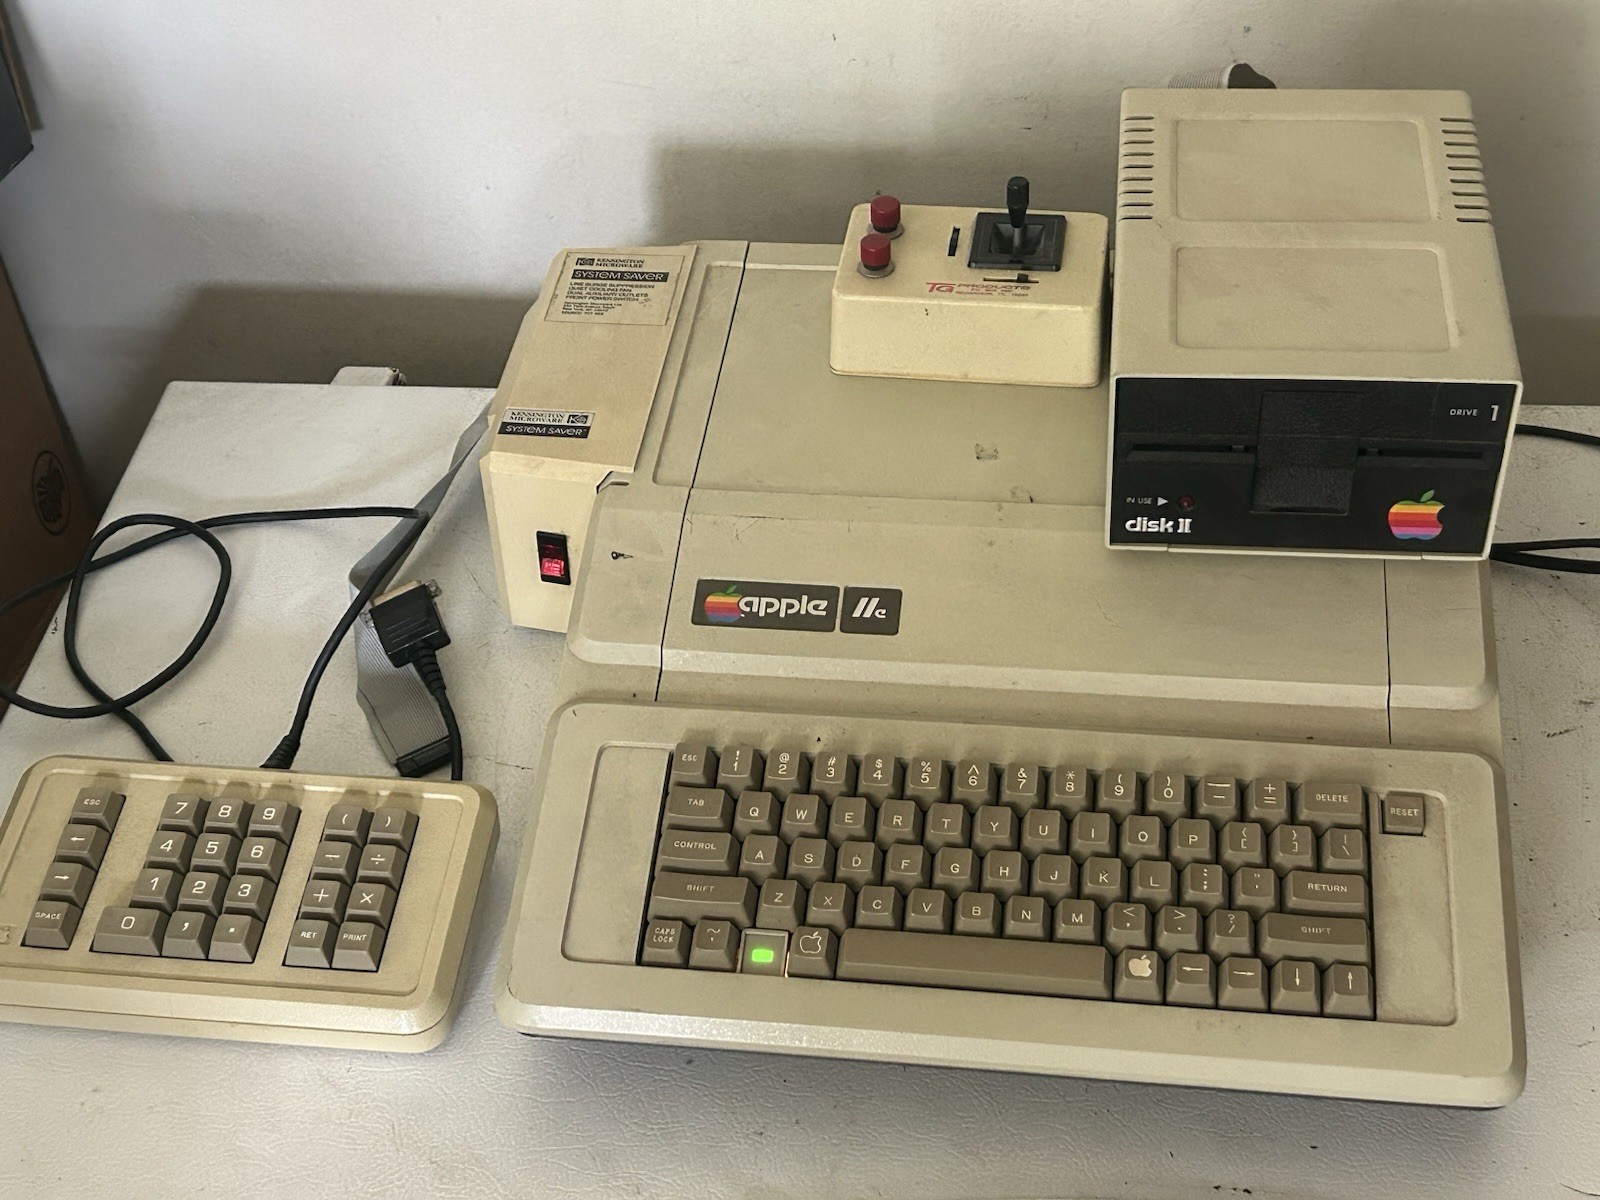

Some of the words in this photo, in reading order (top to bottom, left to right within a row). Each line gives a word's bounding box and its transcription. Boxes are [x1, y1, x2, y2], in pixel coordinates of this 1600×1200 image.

[926, 282, 956, 293] TG
[511, 411, 565, 419] KENSINGTON
[1449, 408, 1478, 417] DRIVE
[1490, 404, 1499, 422] 1
[1137, 497, 1153, 505] USE
[1124, 516, 1175, 533] disk
[738, 594, 829, 618] apple
[681, 754, 698, 762] ESC
[736, 750, 741, 760] !
[779, 752, 790, 764] @
[733, 762, 739, 772] 1
[827, 756, 837, 767] #
[875, 758, 883, 769] $
[920, 761, 932, 773] %
[778, 763, 787, 775] 2
[826, 767, 835, 778] 3
[1017, 767, 1028, 779] &
[872, 769, 883, 781] 4
[920, 772, 930, 784] 5
[968, 775, 978, 786] 6
[1117, 773, 1122, 784] (
[1017, 778, 1027, 790] 7
[1065, 781, 1075, 793] 8
[1166, 776, 1172, 787] )
[1114, 784, 1125, 796] 9
[1263, 783, 1276, 794] +
[83, 798, 101, 806] ESC
[688, 798, 705, 807] TAB
[1315, 793, 1349, 803] DELETE
[174, 801, 189, 815] 7
[218, 805, 233, 818] 8
[262, 807, 276, 820] 9
[749, 806, 760, 817] Q
[1389, 807, 1420, 817] RESET
[795, 808, 808, 821] W
[844, 812, 854, 824] E
[892, 814, 903, 827] R
[941, 818, 952, 830] T
[989, 821, 1000, 833] Y
[1038, 824, 1049, 836] U
[1137, 831, 1149, 842] O
[1188, 834, 1199, 846] P
[159, 839, 175, 852] 4
[205, 841, 220, 855] 5
[673, 840, 717, 850] CONTROL
[250, 845, 265, 858] 6
[754, 850, 765, 861] A
[803, 853, 814, 864] S
[852, 856, 862, 868] D
[901, 859, 911, 870] F
[950, 862, 961, 874] G
[999, 866, 1010, 878] H
[1049, 870, 1059, 881] J
[1099, 872, 1109, 883] K
[150, 876, 160, 891] 1
[191, 880, 208, 894] 2
[1149, 876, 1160, 887] L
[237, 883, 252, 897] 3
[686, 884, 716, 894] SHIFT
[1307, 882, 1348, 893] RETURN
[313, 888, 330, 903] +
[773, 892, 784, 903] Z
[822, 896, 834, 906] X
[872, 900, 882, 910] C
[922, 902, 933, 913] V
[34, 911, 63, 920] SPACE
[971, 906, 982, 917] B
[1021, 909, 1032, 921] N
[1071, 913, 1083, 923] M
[1227, 913, 1236, 924] ?
[300, 931, 318, 939] RET
[654, 926, 677, 936] CAPS
[1300, 926, 1332, 935] SHIFT
[342, 933, 368, 942] PRINT
[652, 934, 675, 944] LOCK
